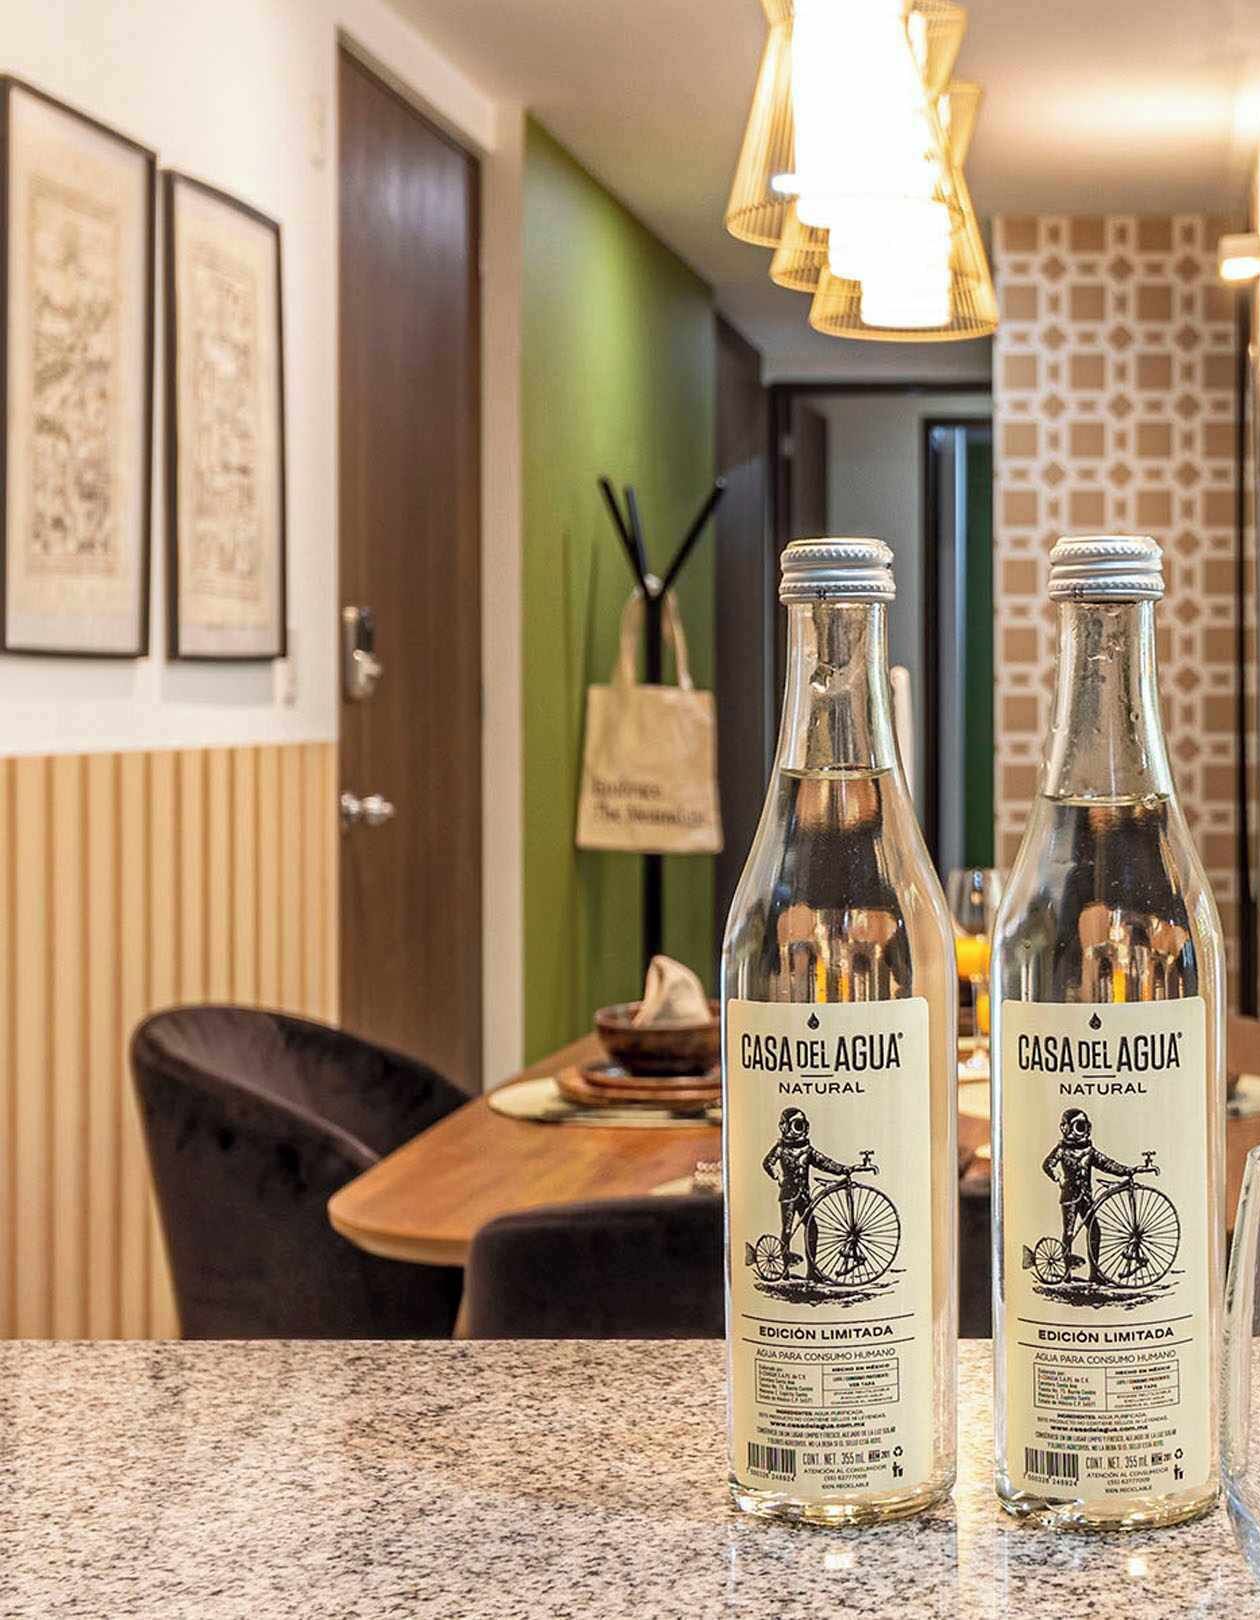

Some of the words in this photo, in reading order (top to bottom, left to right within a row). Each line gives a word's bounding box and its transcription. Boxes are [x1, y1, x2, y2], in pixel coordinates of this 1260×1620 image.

[742, 1033, 793, 1072] CASA
[796, 1040, 830, 1068] DEL
[834, 1033, 900, 1072] AGUA
[1018, 1034, 1075, 1072] CASA
[1078, 1040, 1112, 1069] DEL
[1117, 1033, 1180, 1072] AGUA
[779, 1082, 865, 1094] NATURAL
[1059, 1082, 1147, 1095] NATURAL
[759, 1326, 816, 1340] EDICIÓN
[821, 1326, 894, 1340] LIMITADA
[1038, 1329, 1099, 1343] EDICIÓN
[1105, 1327, 1174, 1343] LIMITADA
[756, 1349, 777, 1358] AGUA
[778, 1352, 801, 1360] PARA
[804, 1352, 852, 1361] CONSUMO
[854, 1348, 896, 1360] HUMANO
[1035, 1352, 1057, 1360] AGUA
[1060, 1354, 1084, 1364] PARA
[1087, 1354, 1135, 1364] CONSUMO
[1137, 1350, 1176, 1363] HUMANO
[802, 1453, 820, 1465] CONT.
[841, 1452, 854, 1465] 355
[1085, 1456, 1104, 1469] CONT.
[1124, 1455, 1137, 1468] 355
[803, 1466, 836, 1474] ATENCIÓN
[1086, 1471, 1120, 1479] ATENCIÓN
